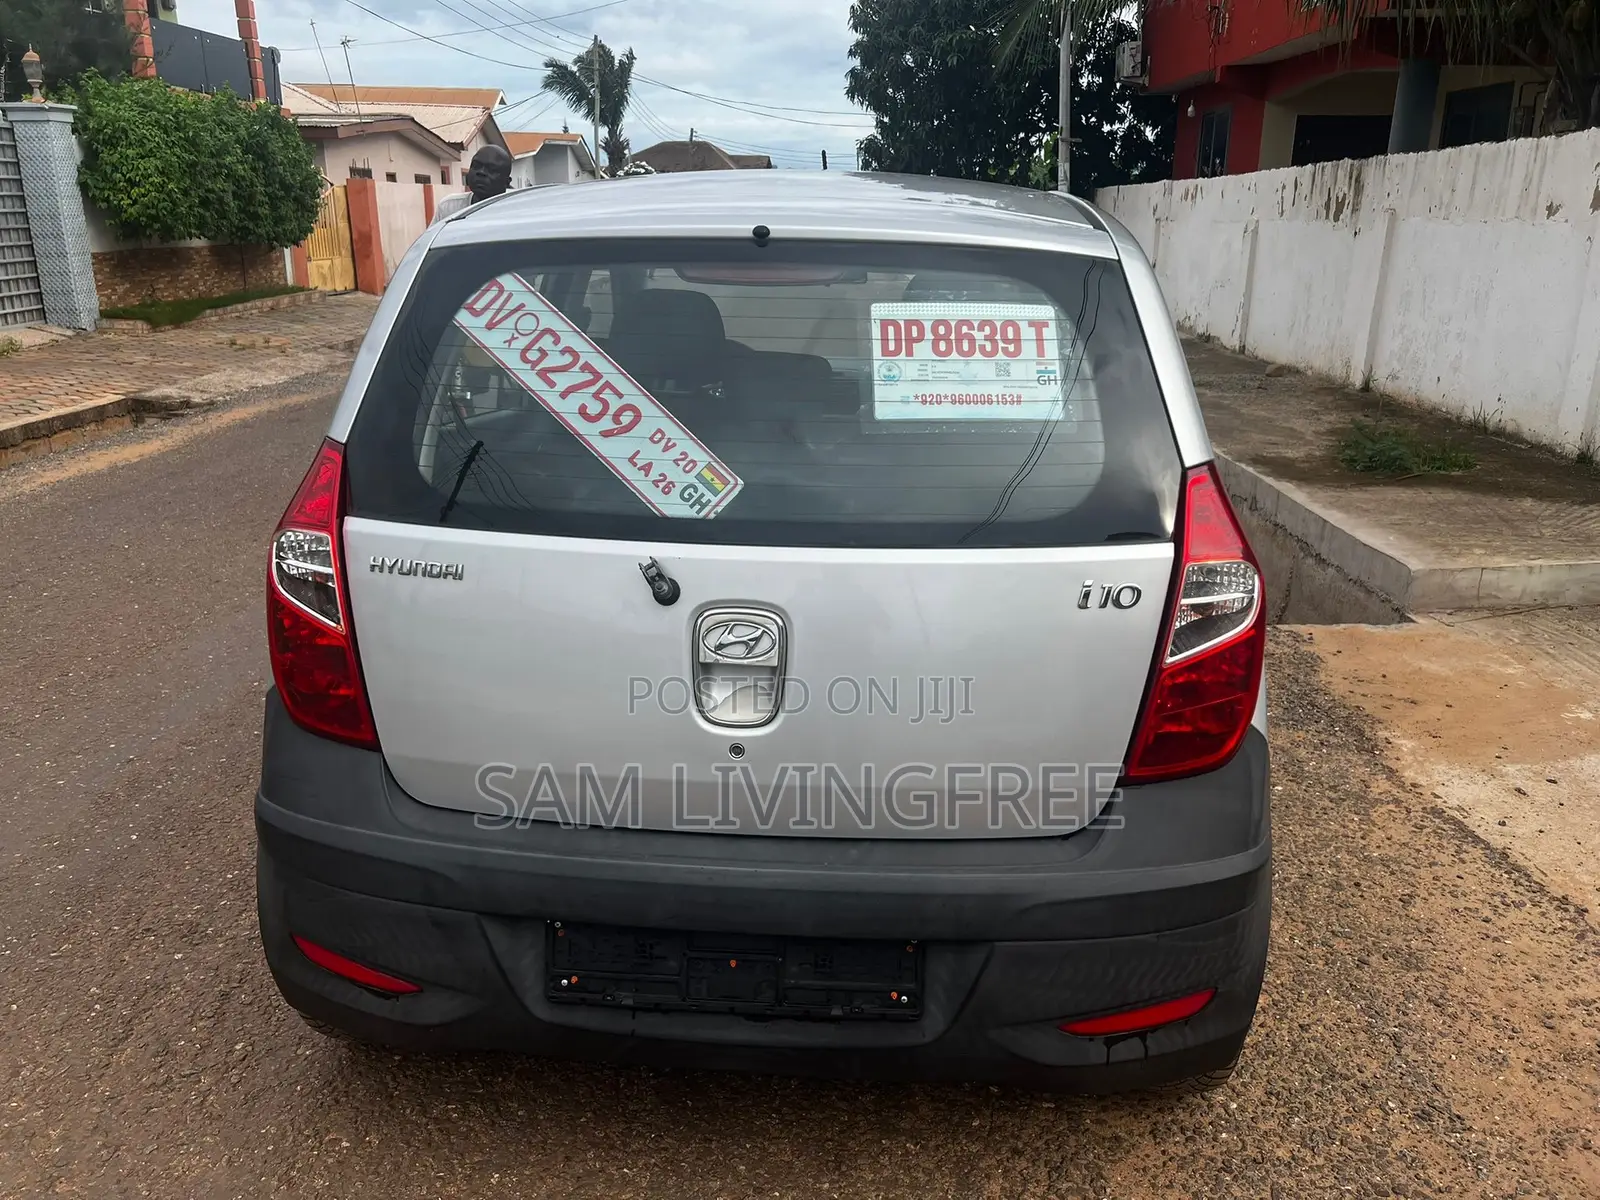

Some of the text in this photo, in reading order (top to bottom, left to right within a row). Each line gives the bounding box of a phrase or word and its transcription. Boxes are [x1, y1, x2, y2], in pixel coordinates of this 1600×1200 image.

[880, 319, 1049, 358] DP 8639 T
[464, 279, 526, 330] DV
[520, 327, 642, 438] G2759
[1037, 375, 1058, 386] GH
[648, 428, 698, 474] DV 20
[628, 449, 676, 496] LA 26
[679, 483, 712, 515] GH
[370, 556, 464, 581] HYUNDAI
